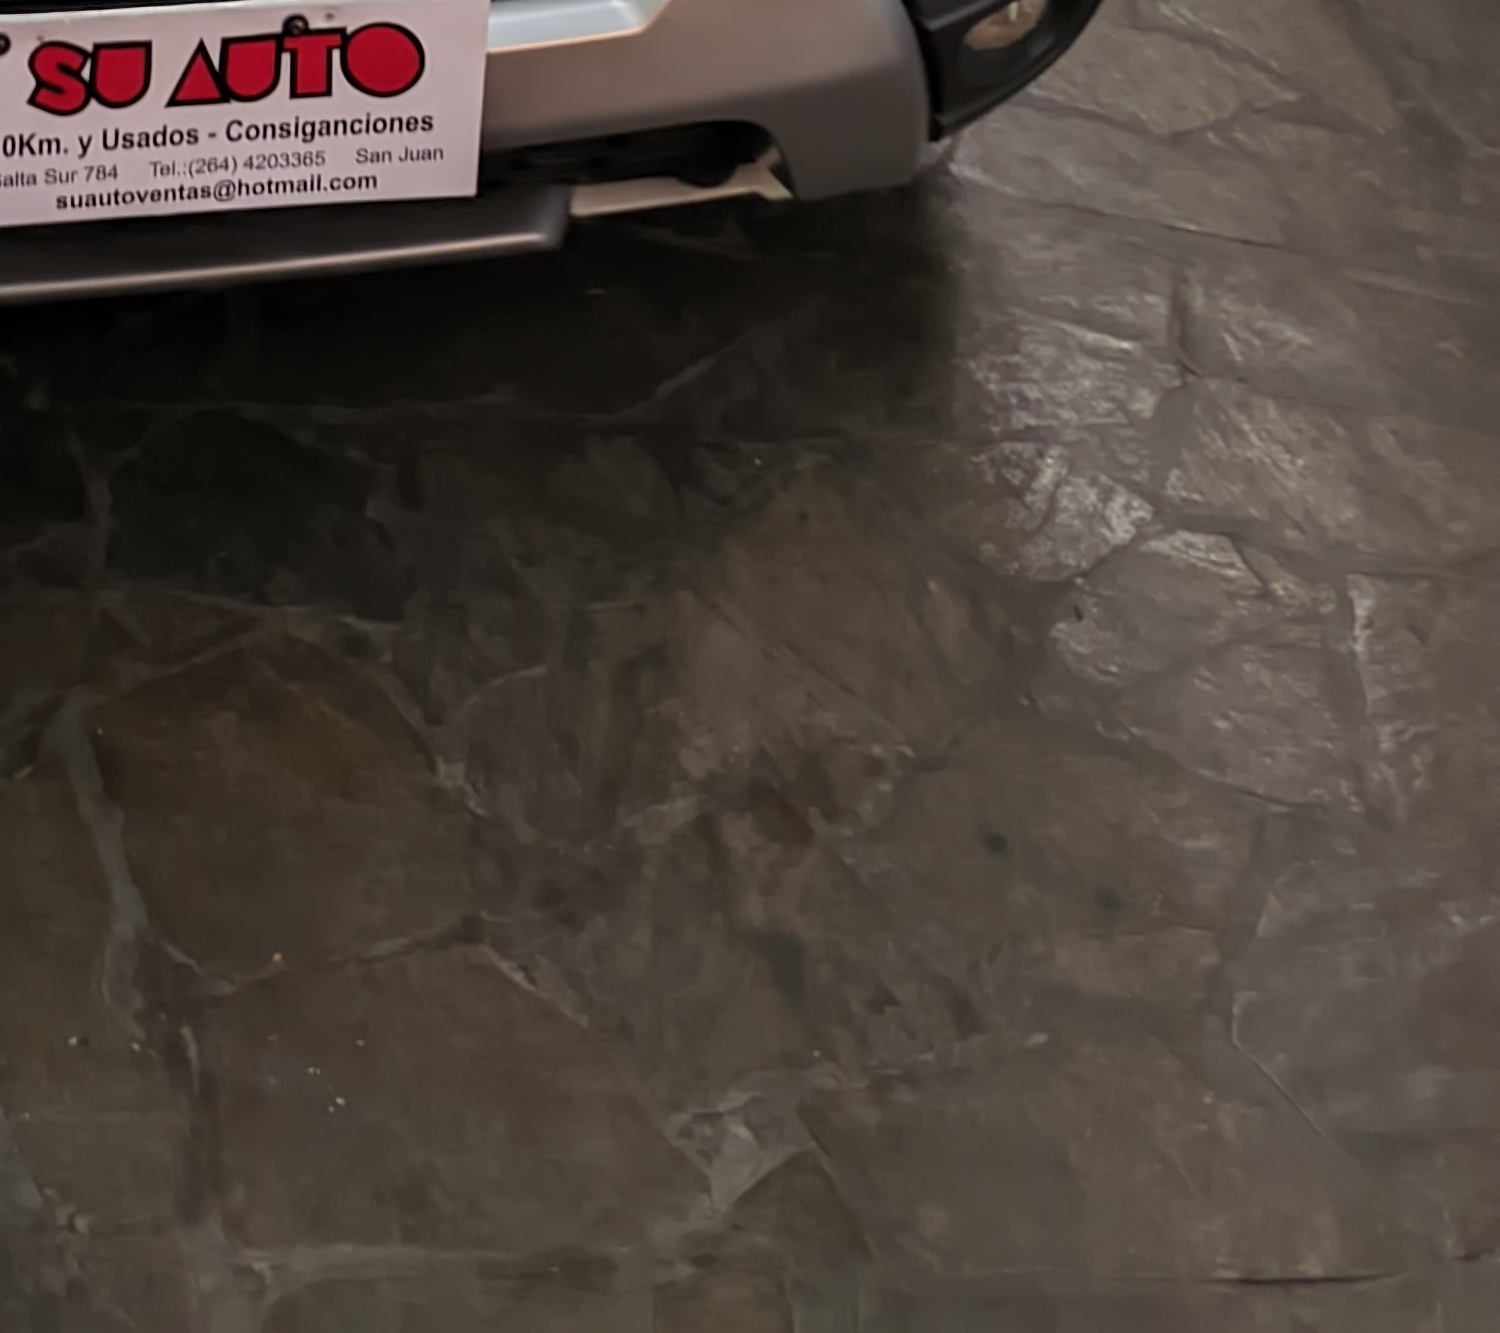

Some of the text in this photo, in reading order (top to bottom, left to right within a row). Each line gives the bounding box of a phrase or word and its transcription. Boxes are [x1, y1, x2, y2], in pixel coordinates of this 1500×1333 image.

[27, 22, 426, 116] SU AUTO
[2, 132, 70, 158] 0Km.
[77, 134, 93, 159] y
[102, 124, 200, 151] Usados
[225, 112, 435, 143] Consiganciones
[44, 167, 78, 186] Sur
[83, 163, 119, 183] 784
[242, 150, 327, 172] 4203365
[355, 147, 393, 165] San
[398, 145, 444, 164] Juan
[55, 174, 379, 211] suautoventas@hotmail.com
